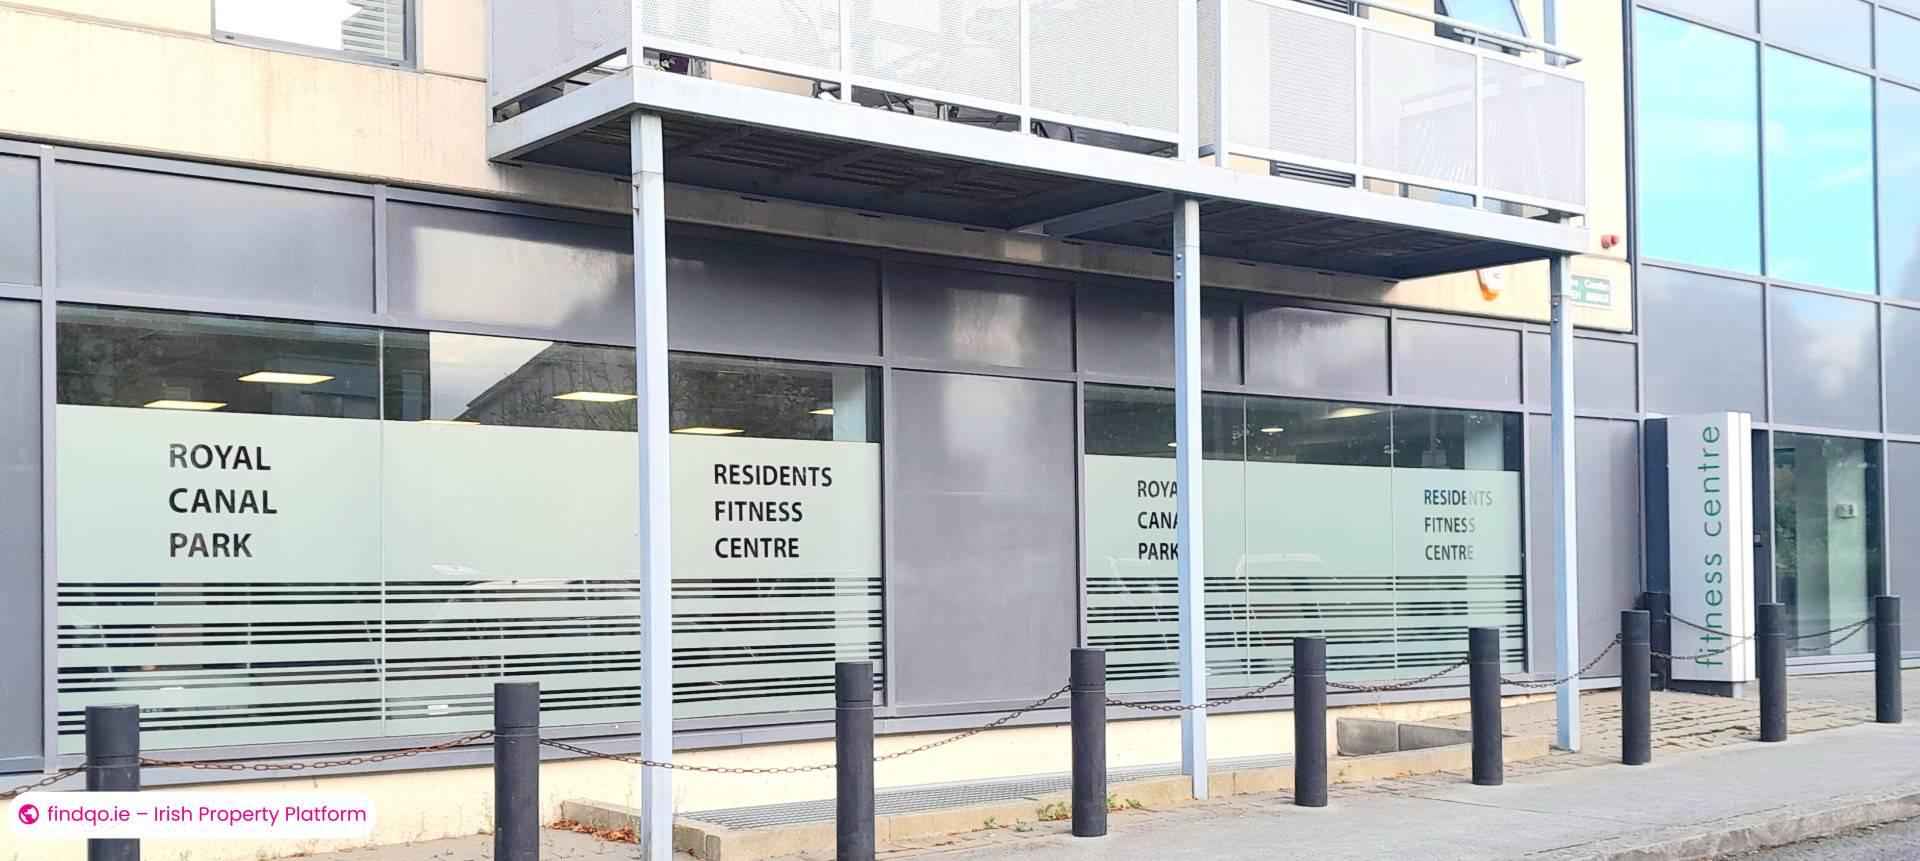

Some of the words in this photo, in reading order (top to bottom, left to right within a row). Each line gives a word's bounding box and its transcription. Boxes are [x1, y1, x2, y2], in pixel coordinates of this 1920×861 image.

[169, 443, 271, 471] ROYAL
[714, 463, 832, 487] RESIDENTS
[1697, 424, 1723, 537] centre
[1137, 479, 1178, 498] ROYA
[1424, 489, 1493, 506] RESIDENTS
[168, 487, 278, 514] CANAL
[714, 500, 803, 522] FITNESS
[1137, 511, 1178, 529] CAN
[1424, 517, 1476, 533] FITNESS
[169, 532, 252, 558] PARK
[715, 537, 799, 558] CENTRE
[1138, 542, 1179, 560] PARK
[1425, 544, 1475, 561] CENTRE
[1695, 553, 1724, 668] fitness
